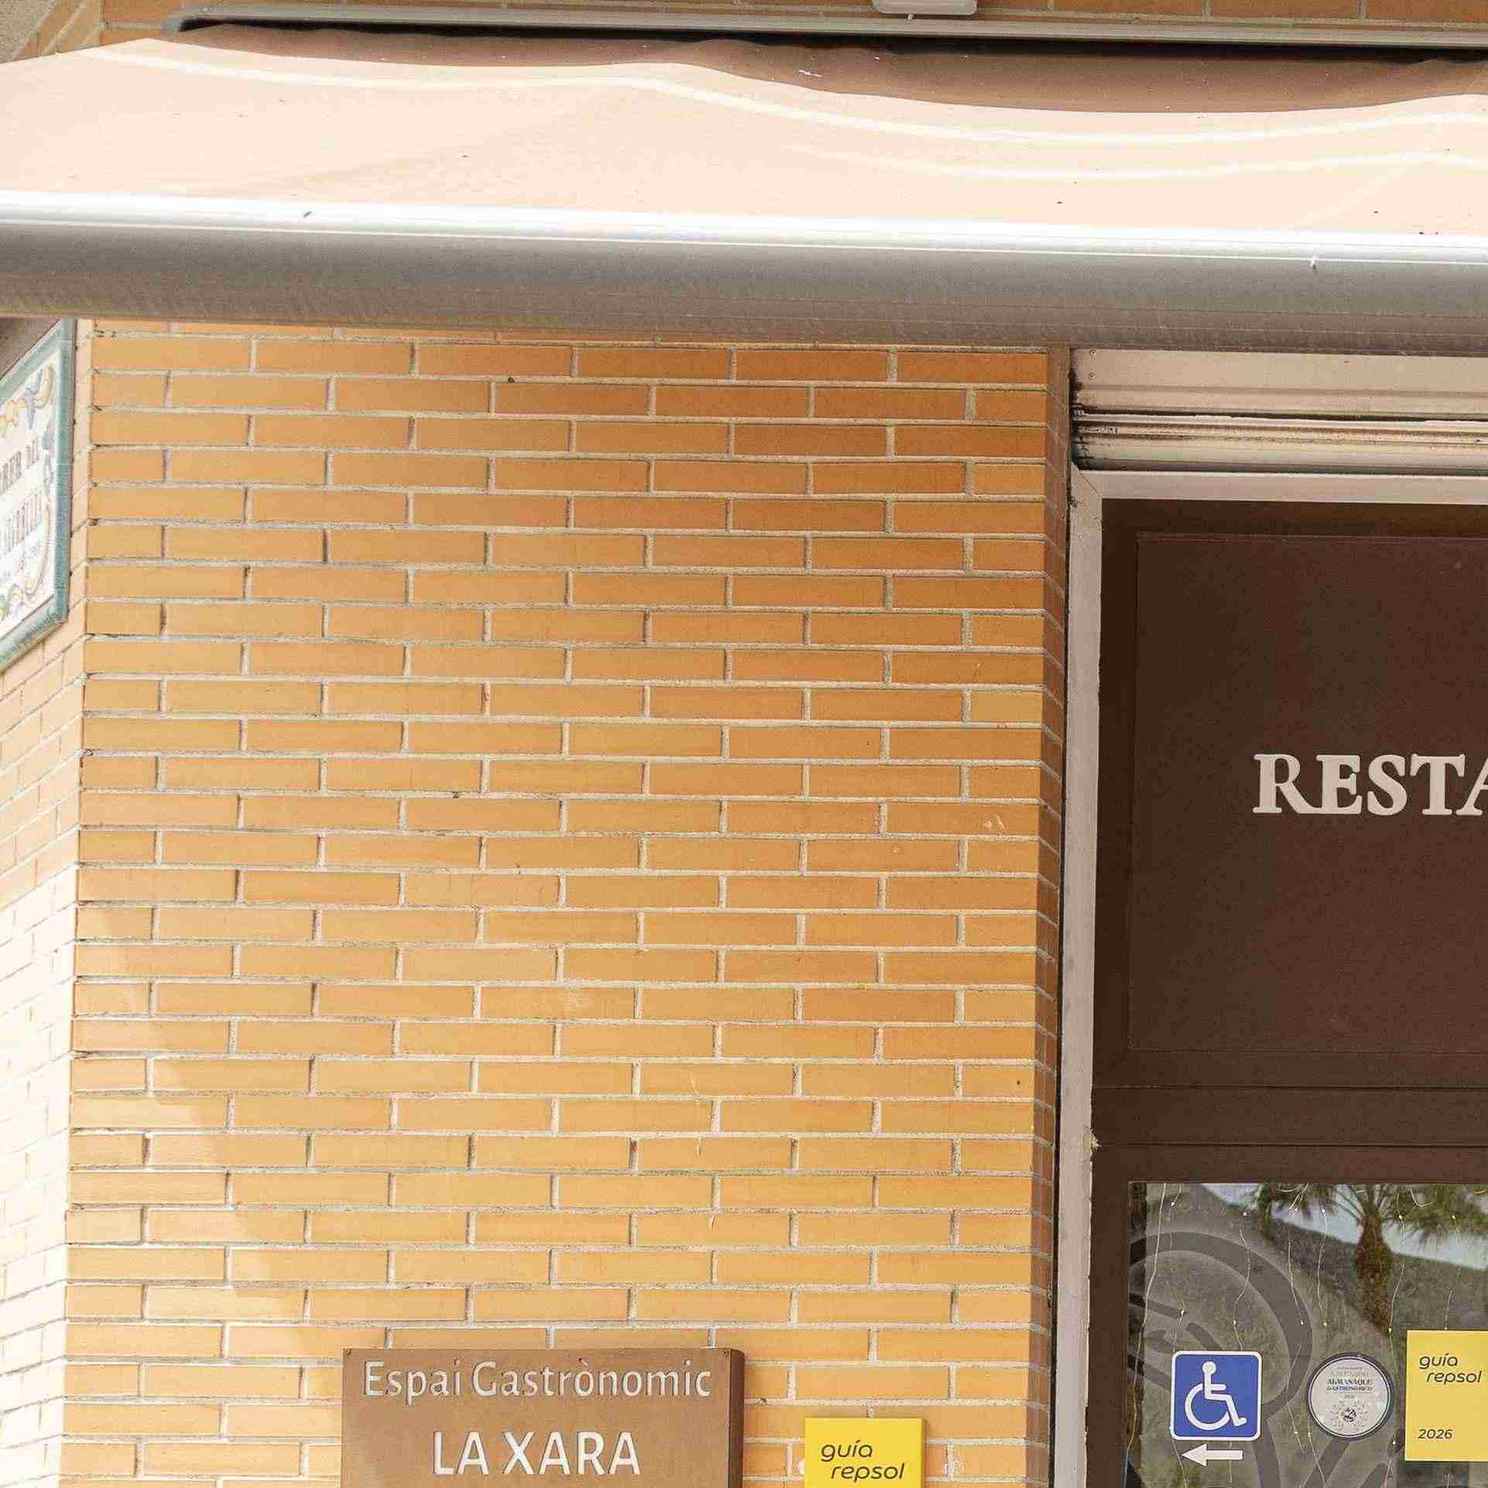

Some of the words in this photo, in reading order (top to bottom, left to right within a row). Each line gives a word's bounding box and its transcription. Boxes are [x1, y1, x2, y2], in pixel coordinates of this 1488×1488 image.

[1418, 1352, 1459, 1370] guía
[364, 1360, 461, 1404] Espai
[472, 1359, 712, 1398] Gastrònomic
[1425, 1371, 1483, 1385] repsol
[1417, 1428, 1454, 1440] 2026
[433, 1431, 489, 1475] LA
[503, 1431, 641, 1475] XARA
[820, 1440, 873, 1463] guía
[831, 1463, 905, 1483] repsol
